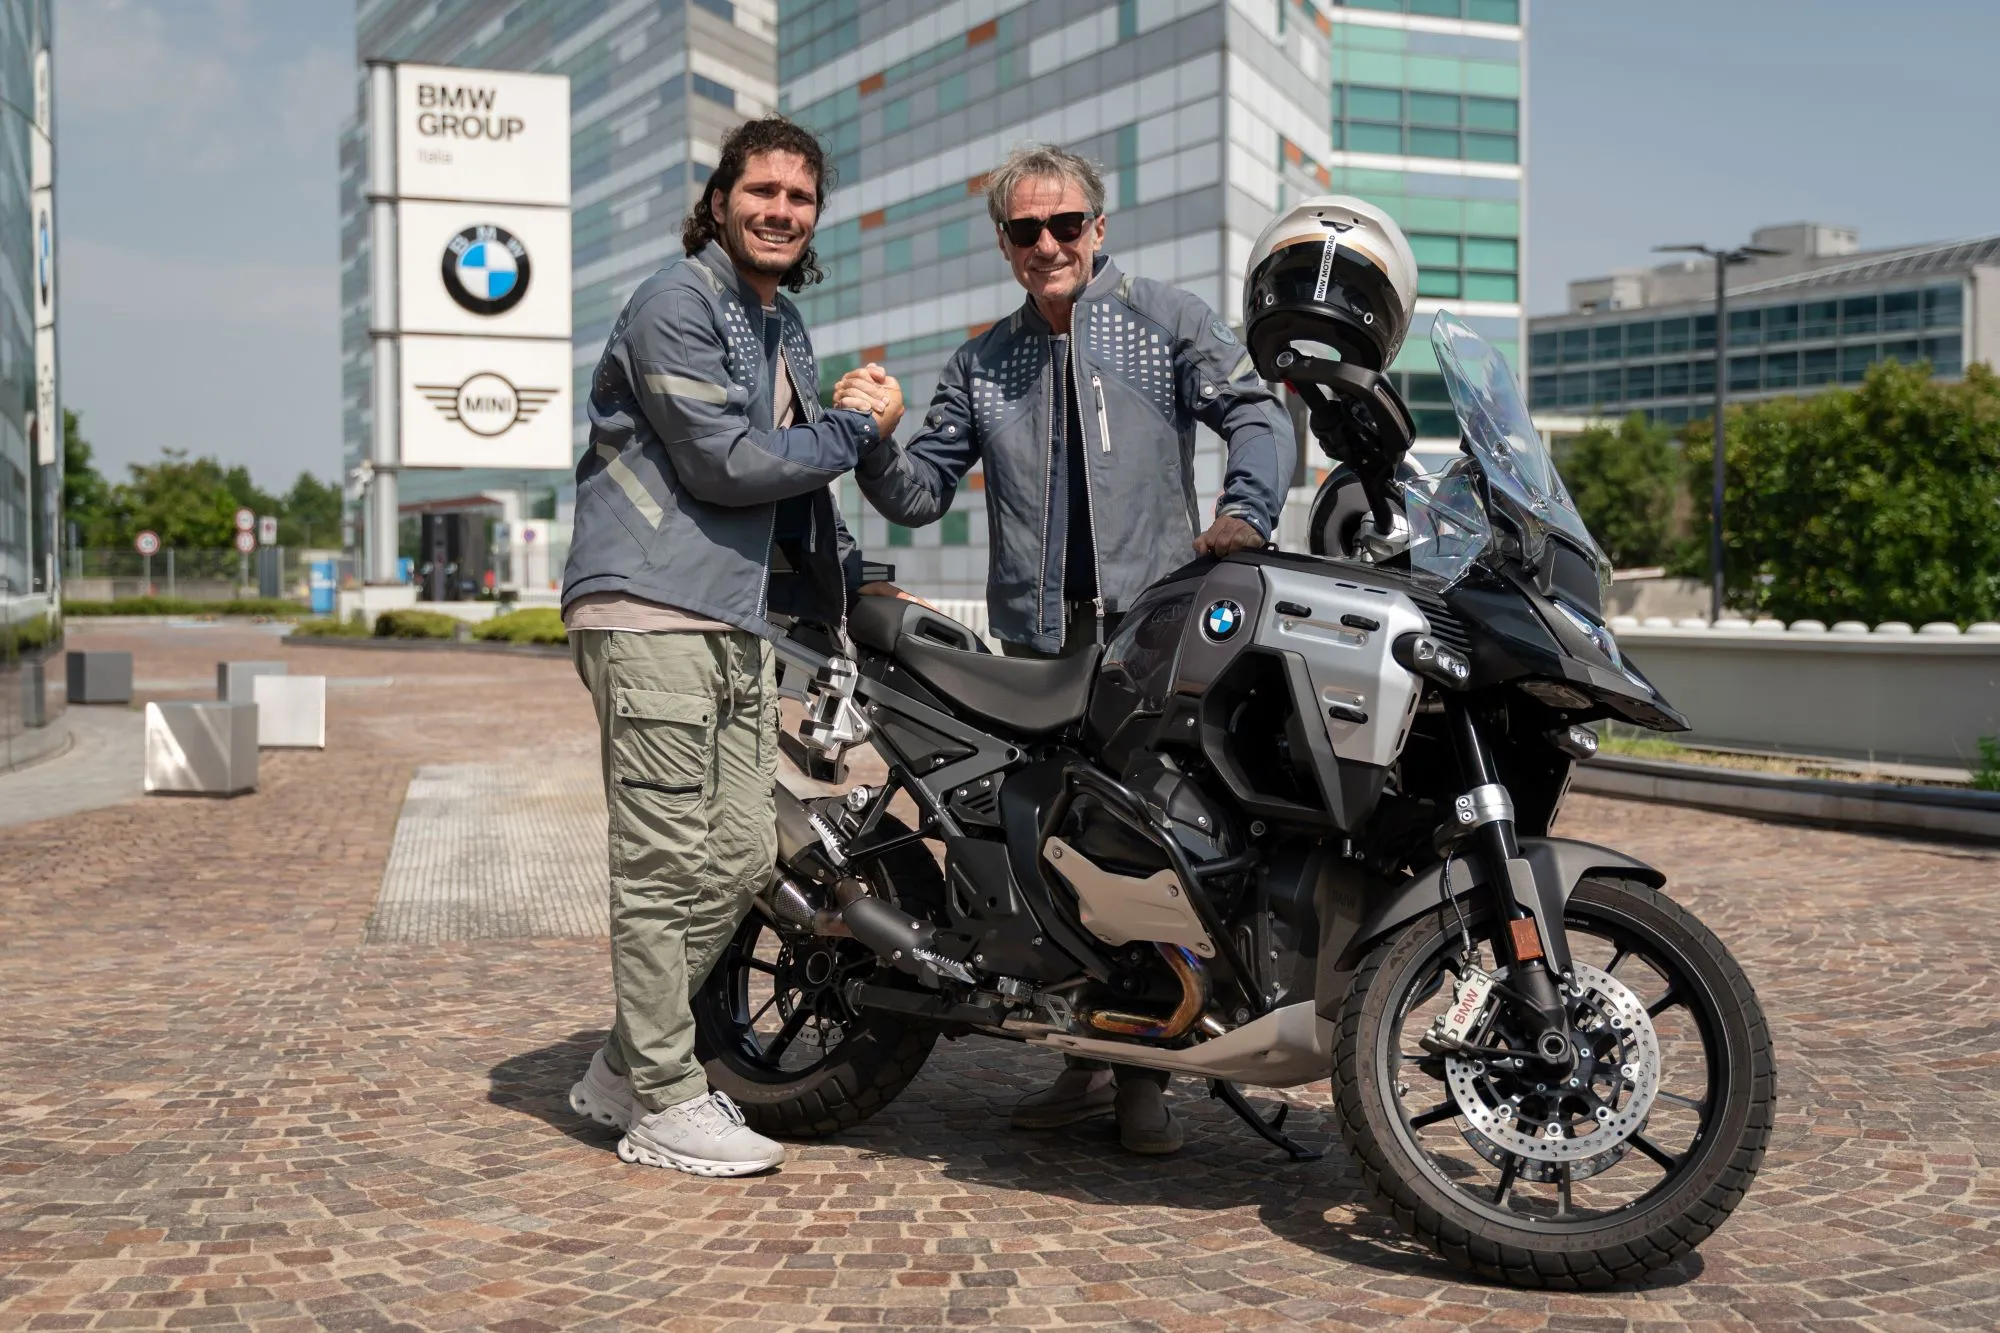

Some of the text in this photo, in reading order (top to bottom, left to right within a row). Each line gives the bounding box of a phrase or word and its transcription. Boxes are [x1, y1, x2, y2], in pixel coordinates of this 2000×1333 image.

[418, 85, 497, 110] BMW
[418, 113, 526, 142] GROUP
[447, 225, 526, 259] BMW
[1316, 234, 1336, 299] BMW MOTORRAD
[465, 397, 512, 412] MINI
[1210, 600, 1241, 617] BMW
[1453, 988, 1479, 1025] BMW
